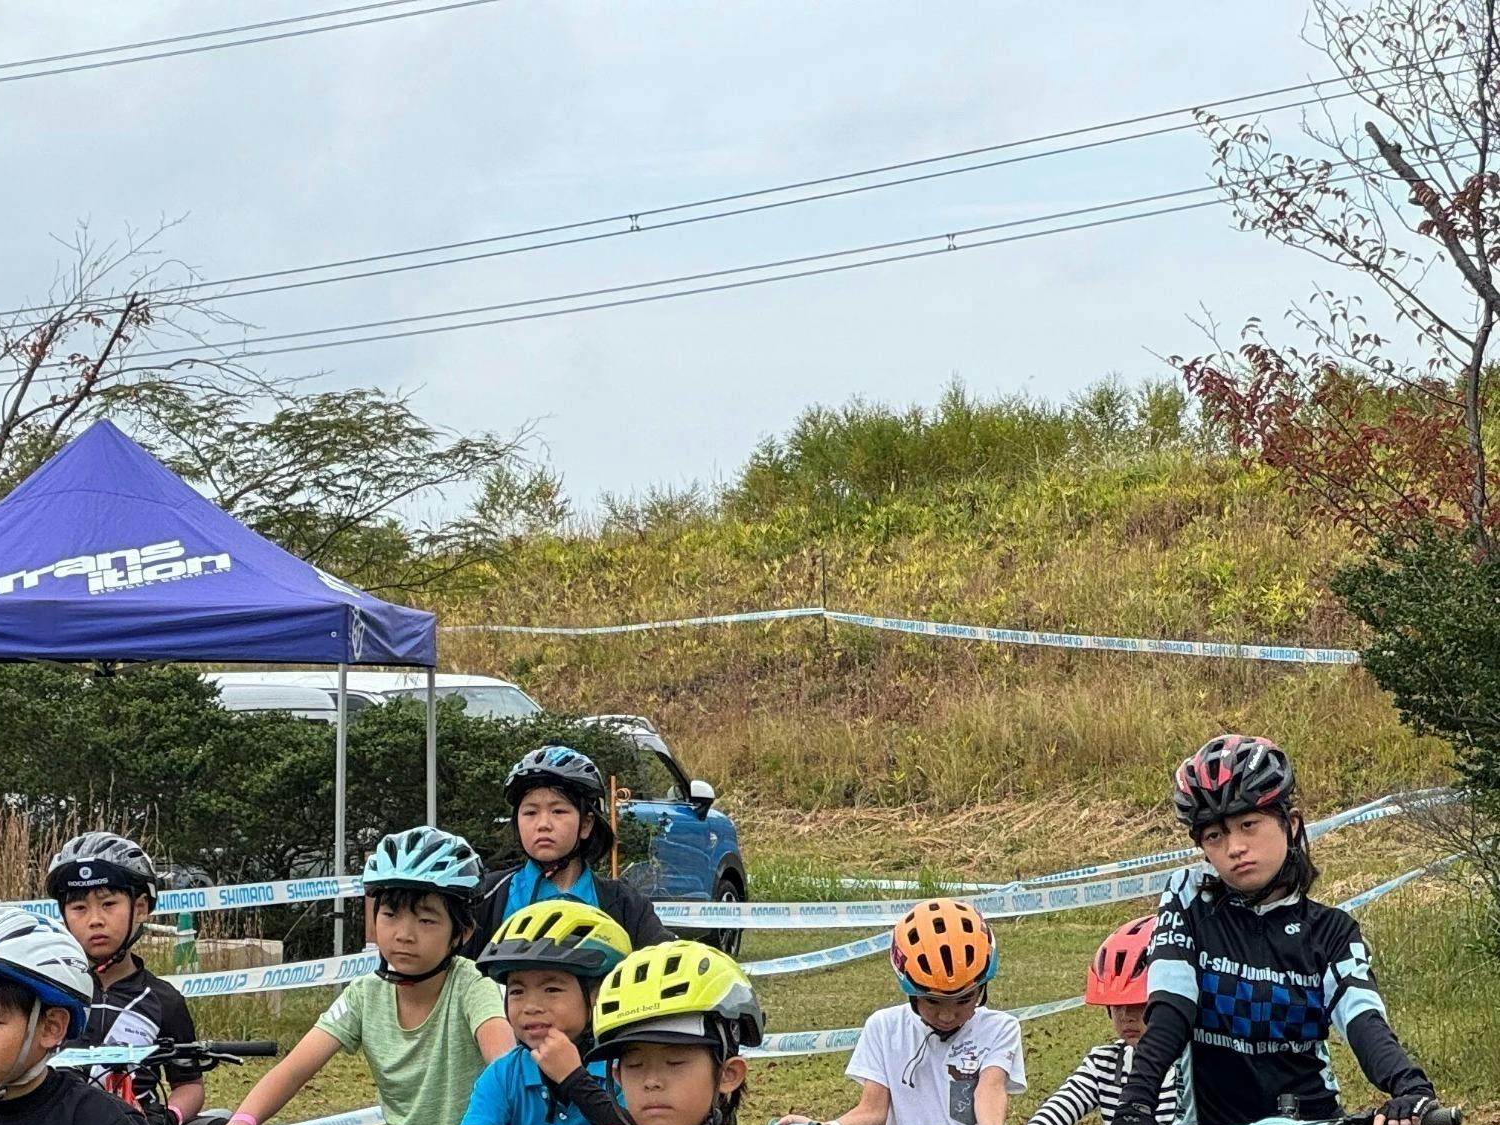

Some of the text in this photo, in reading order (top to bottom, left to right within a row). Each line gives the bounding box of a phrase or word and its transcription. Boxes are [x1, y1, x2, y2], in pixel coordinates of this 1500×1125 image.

[1259, 649, 1305, 661] SHIMANO
[219, 886, 274, 905] SHIMANO
[287, 879, 339, 899] SHIMANO
[1239, 959, 1286, 986] Junior
[1193, 1027, 1254, 1056] Mountain
